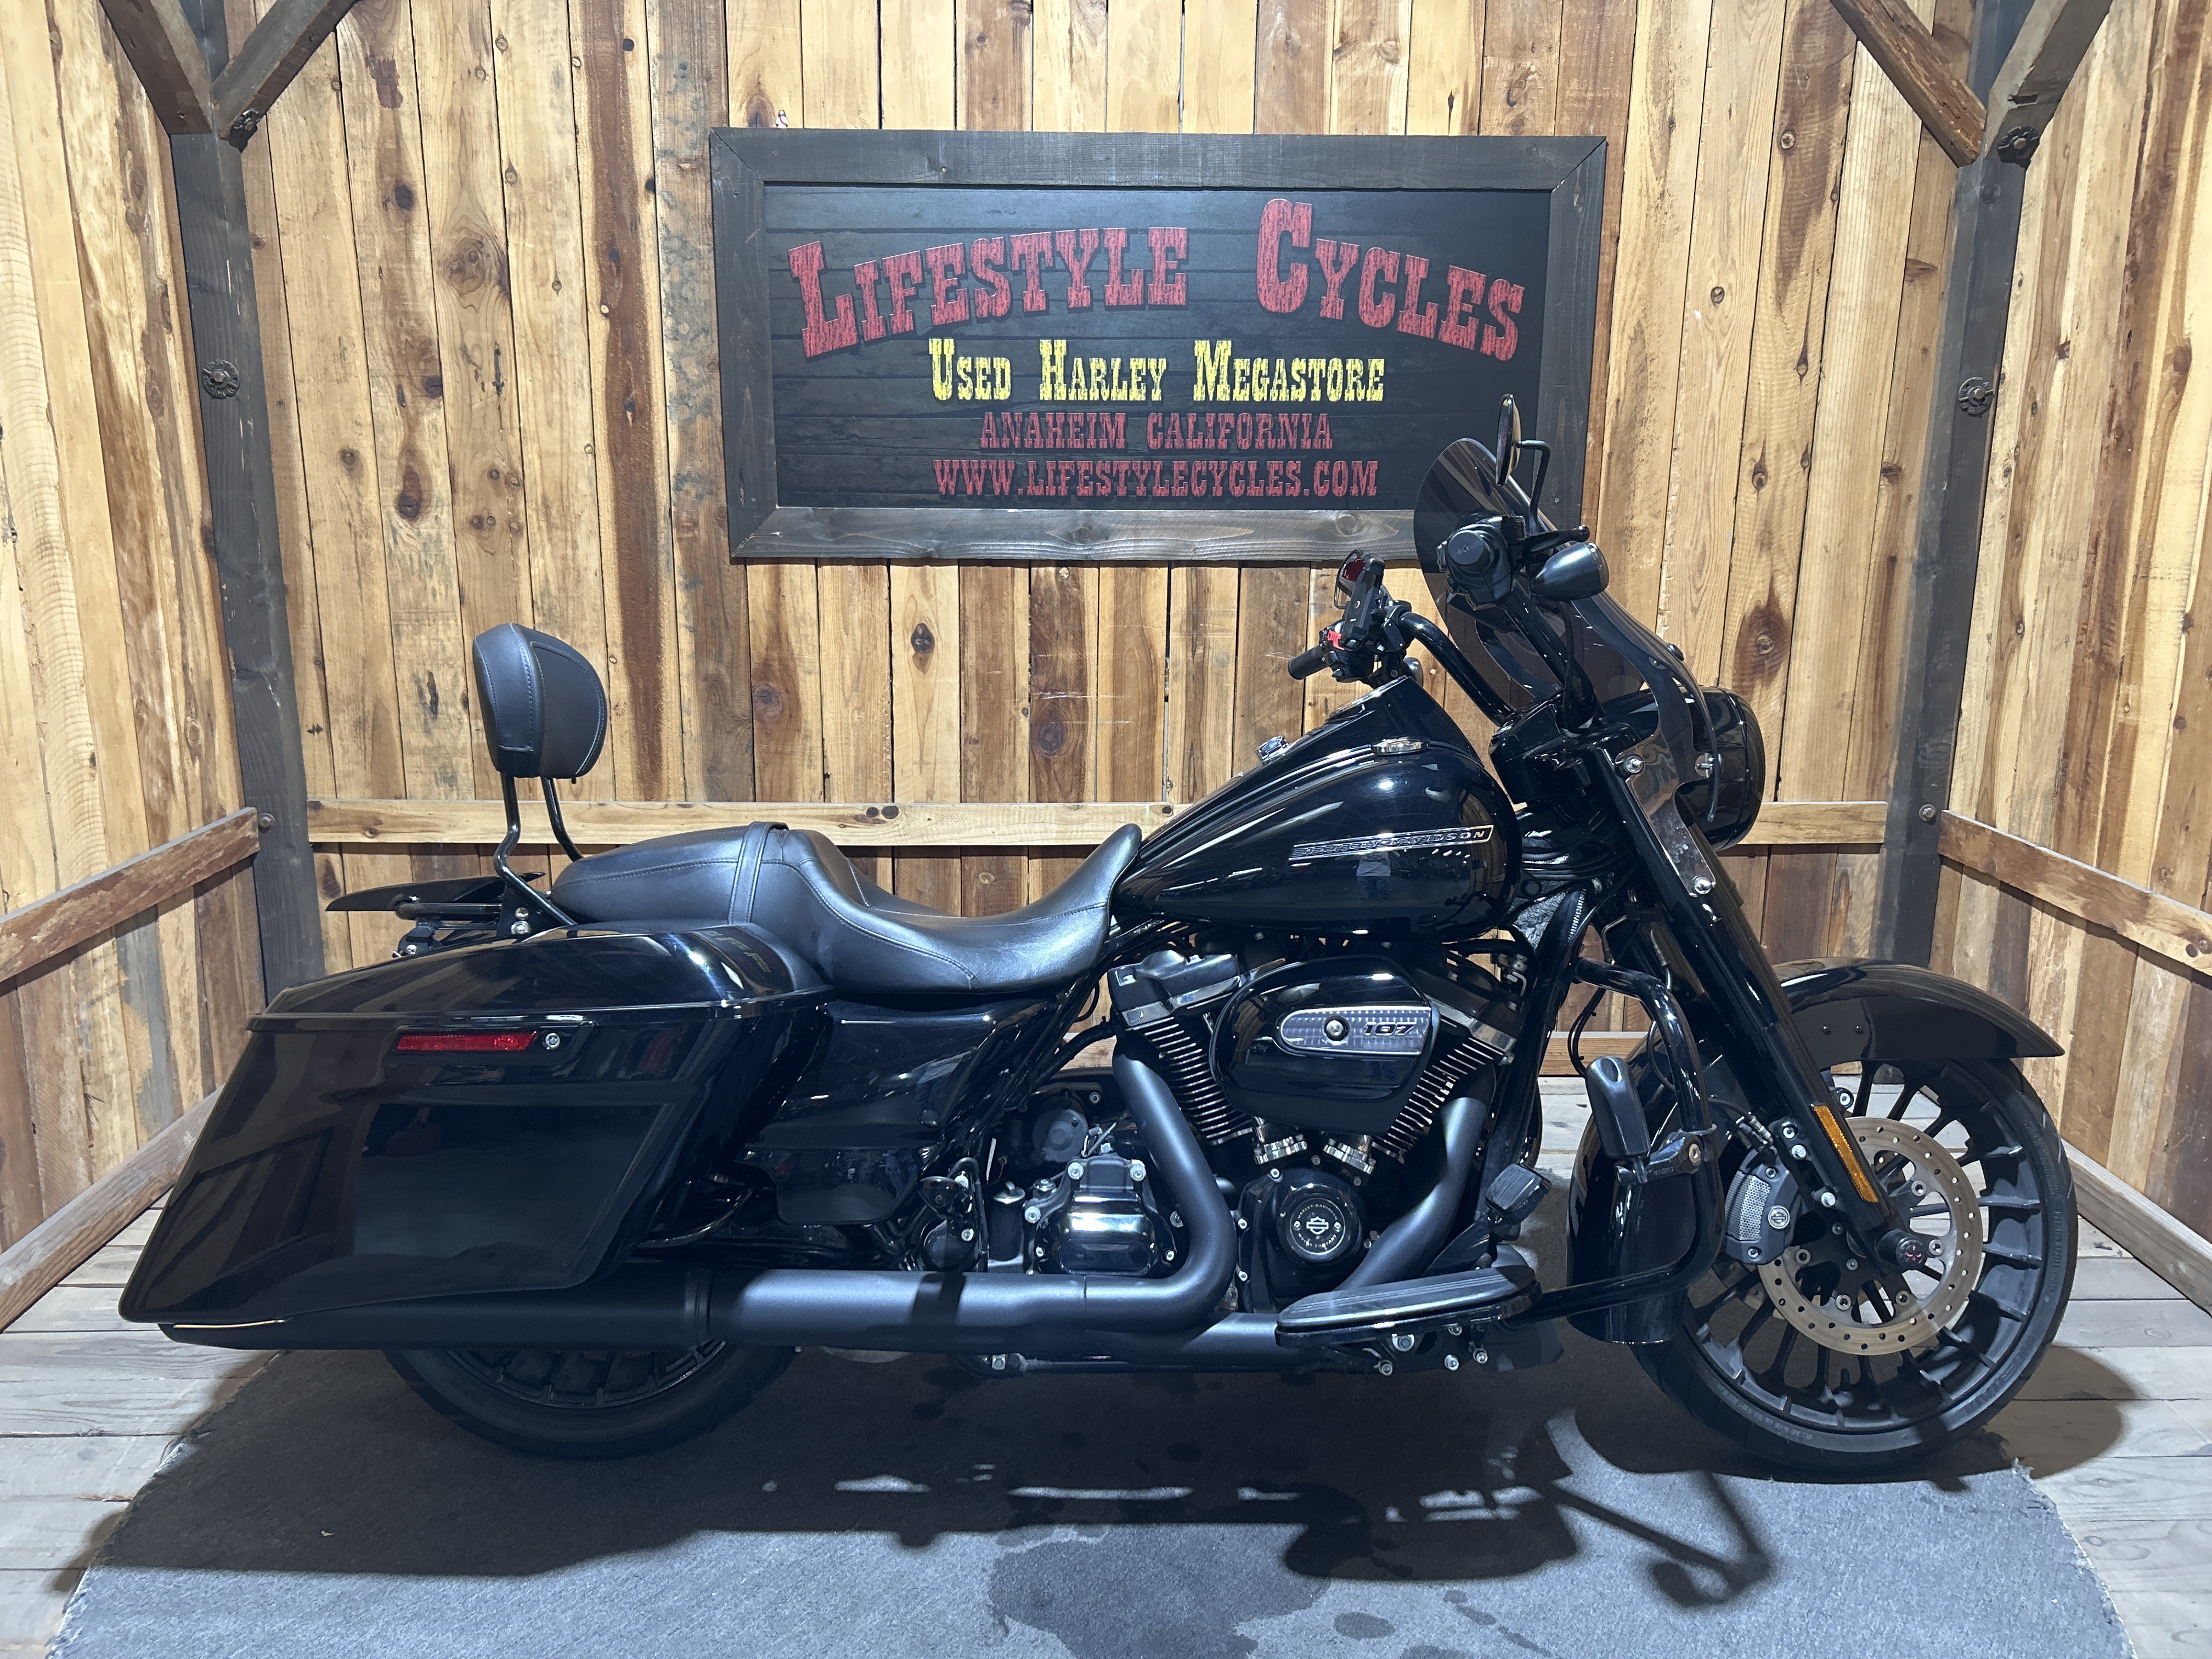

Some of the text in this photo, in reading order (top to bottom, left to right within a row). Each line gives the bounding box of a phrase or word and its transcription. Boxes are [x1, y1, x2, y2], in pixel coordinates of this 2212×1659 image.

[788, 199, 1525, 362] LIFESTYLE CYCLES
[929, 338, 1385, 402] USED HARLEY MEGASTORE
[979, 413, 1333, 450] ANAHEIM CALIFORNIA
[933, 460, 1379, 498] WWW.LIFESTYLECYCLES.COM
[1363, 1021, 1417, 1036] 107
